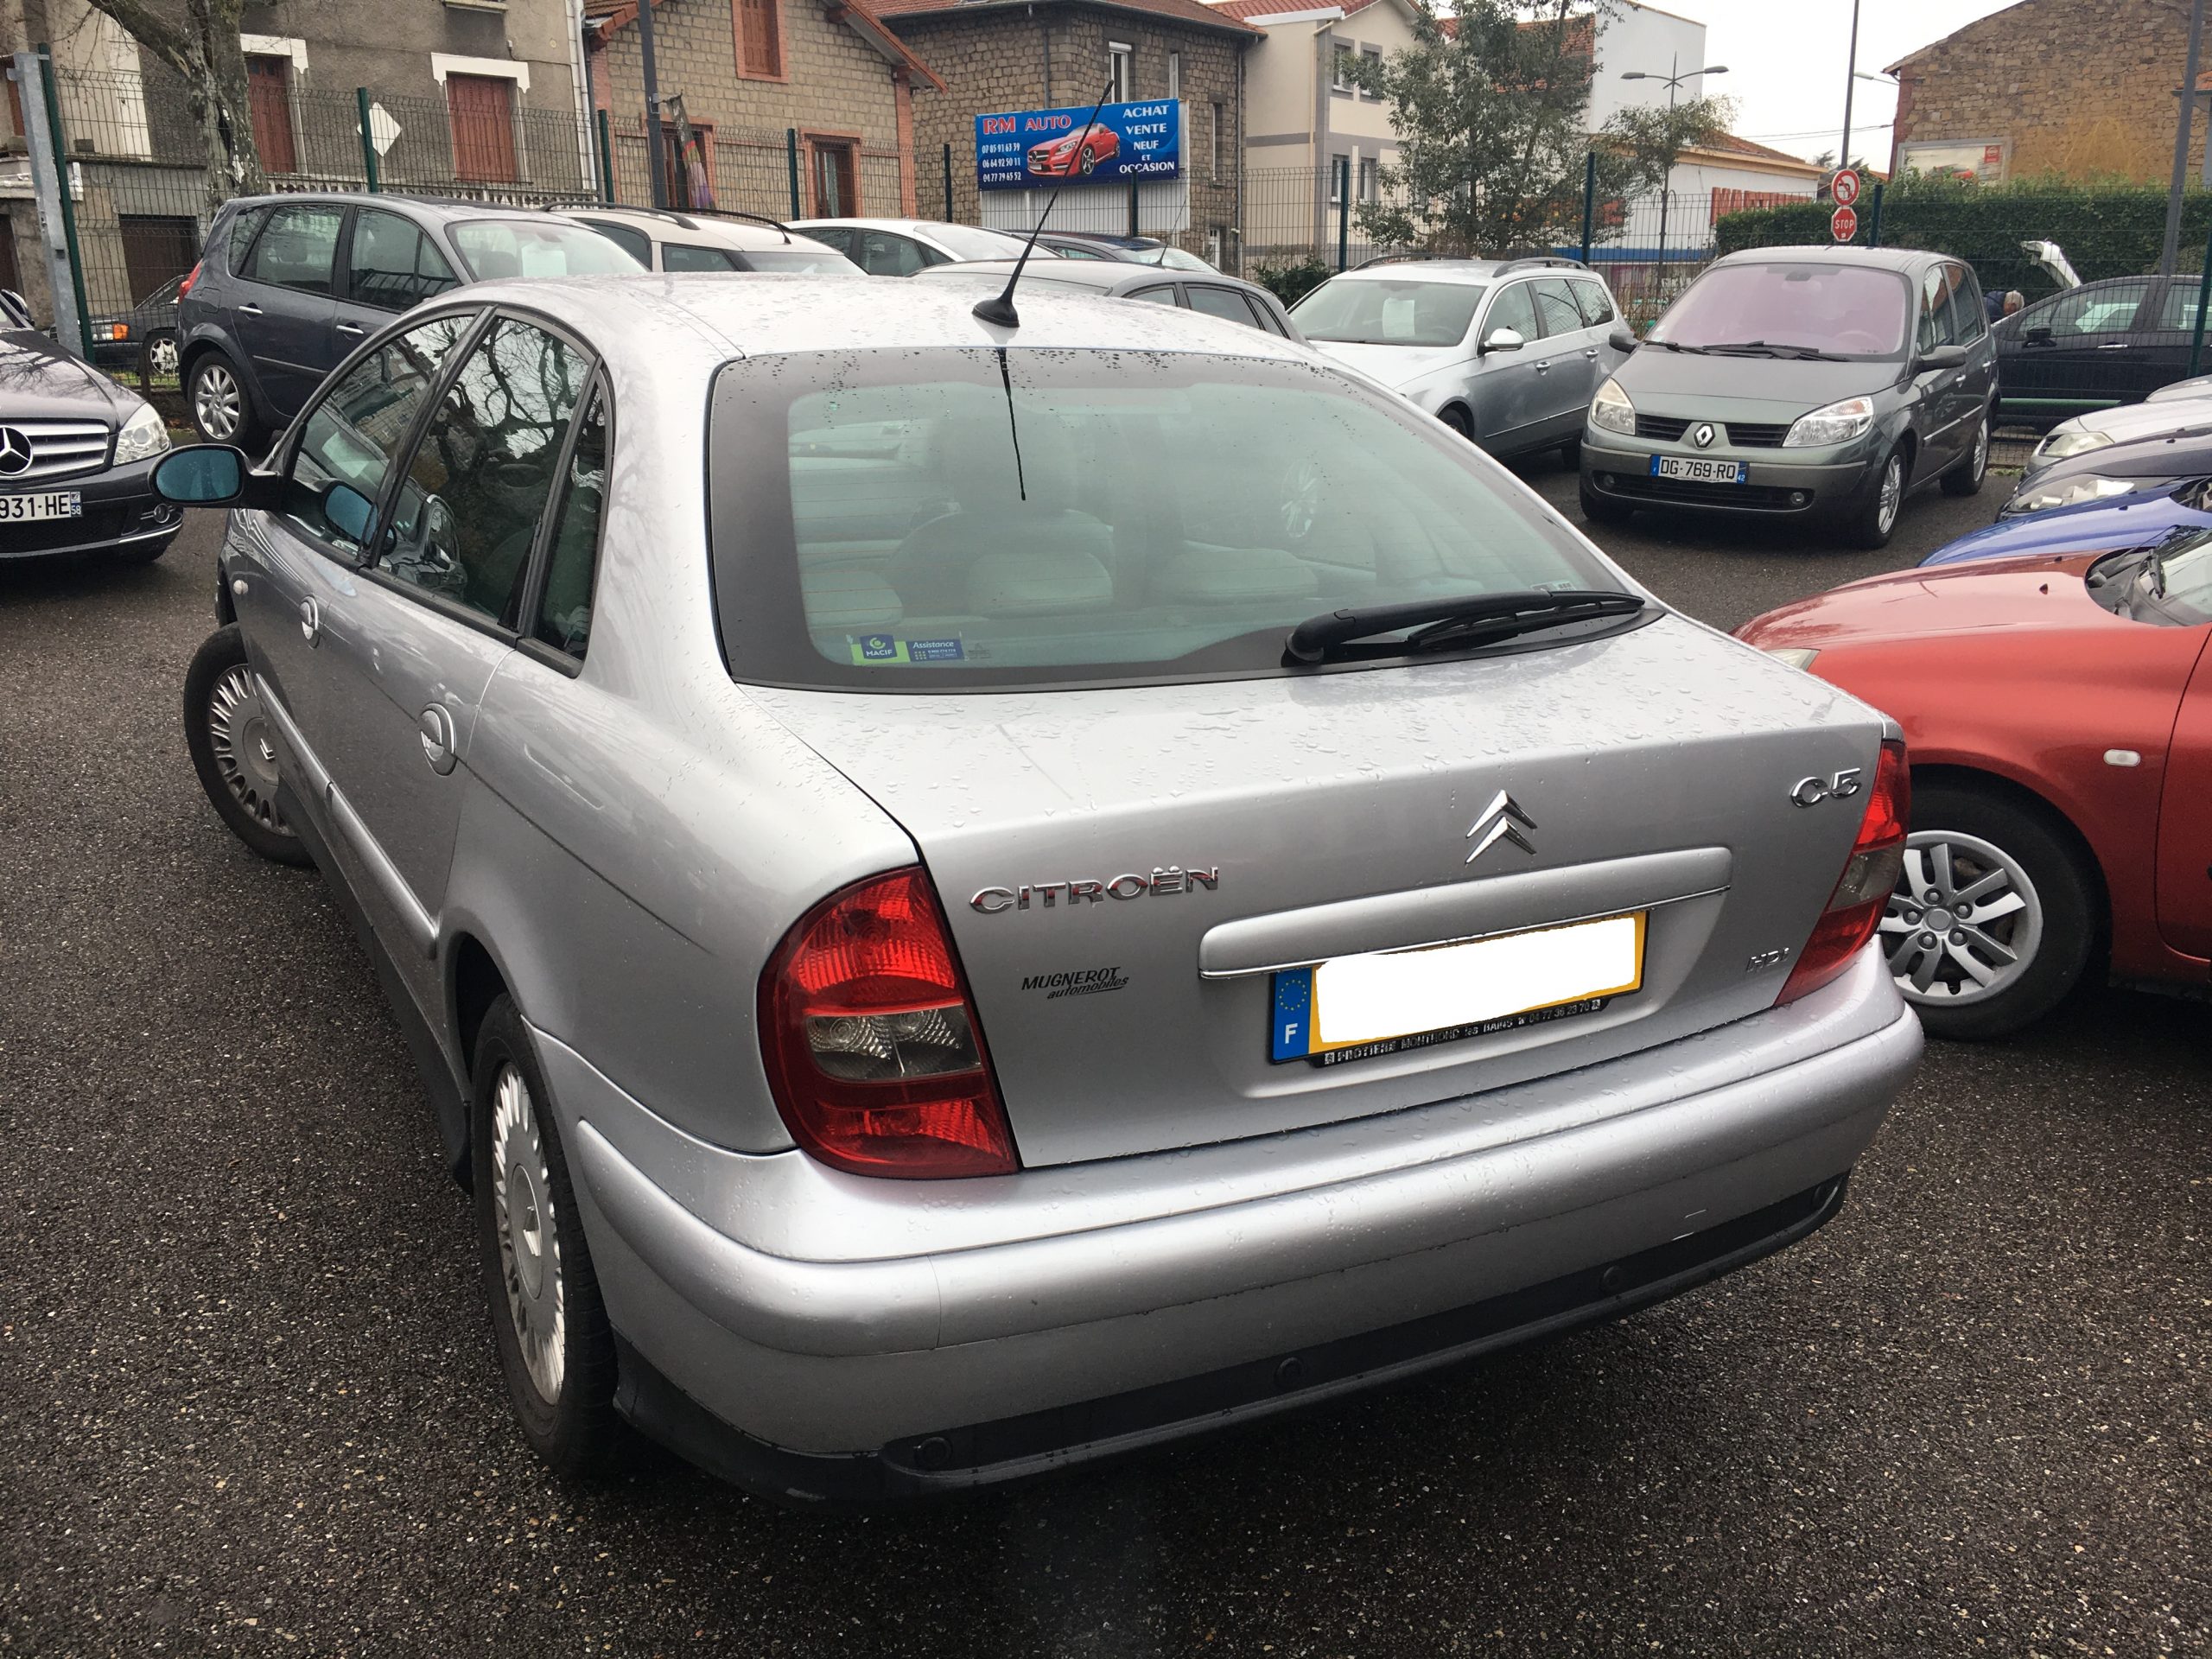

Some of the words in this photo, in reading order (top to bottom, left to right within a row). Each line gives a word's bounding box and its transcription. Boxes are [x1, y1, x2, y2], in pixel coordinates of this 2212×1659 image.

[1122, 105, 1170, 118] ACHAT
[982, 116, 1016, 135] RM
[1025, 114, 1071, 131] AUTO
[1125, 123, 1167, 135] VENTE
[997, 143, 1004, 153] 91
[1134, 139, 1160, 151] NEUF
[982, 159, 989, 168] 06
[990, 158, 997, 168] 64
[998, 158, 1005, 168] 92
[1006, 157, 1014, 167] 50
[1014, 156, 1020, 166] 11
[1119, 161, 1175, 174] OCCASION
[990, 173, 998, 182] 77
[998, 172, 1006, 181] 79
[1006, 172, 1014, 181] 65
[1014, 171, 1021, 181] 52
[1835, 219, 1854, 230] STOP
[1737, 474, 1745, 482] 42
[71, 505, 82, 515] 58
[1789, 767, 1862, 809] C5
[969, 865, 1218, 914] CITROËN
[1021, 966, 1121, 990] MUGNEROT
[1046, 976, 1129, 1000] automobiles
[1567, 1004, 1577, 1015] 23
[1580, 1001, 1590, 1013] 70
[1284, 1022, 1299, 1045] F
